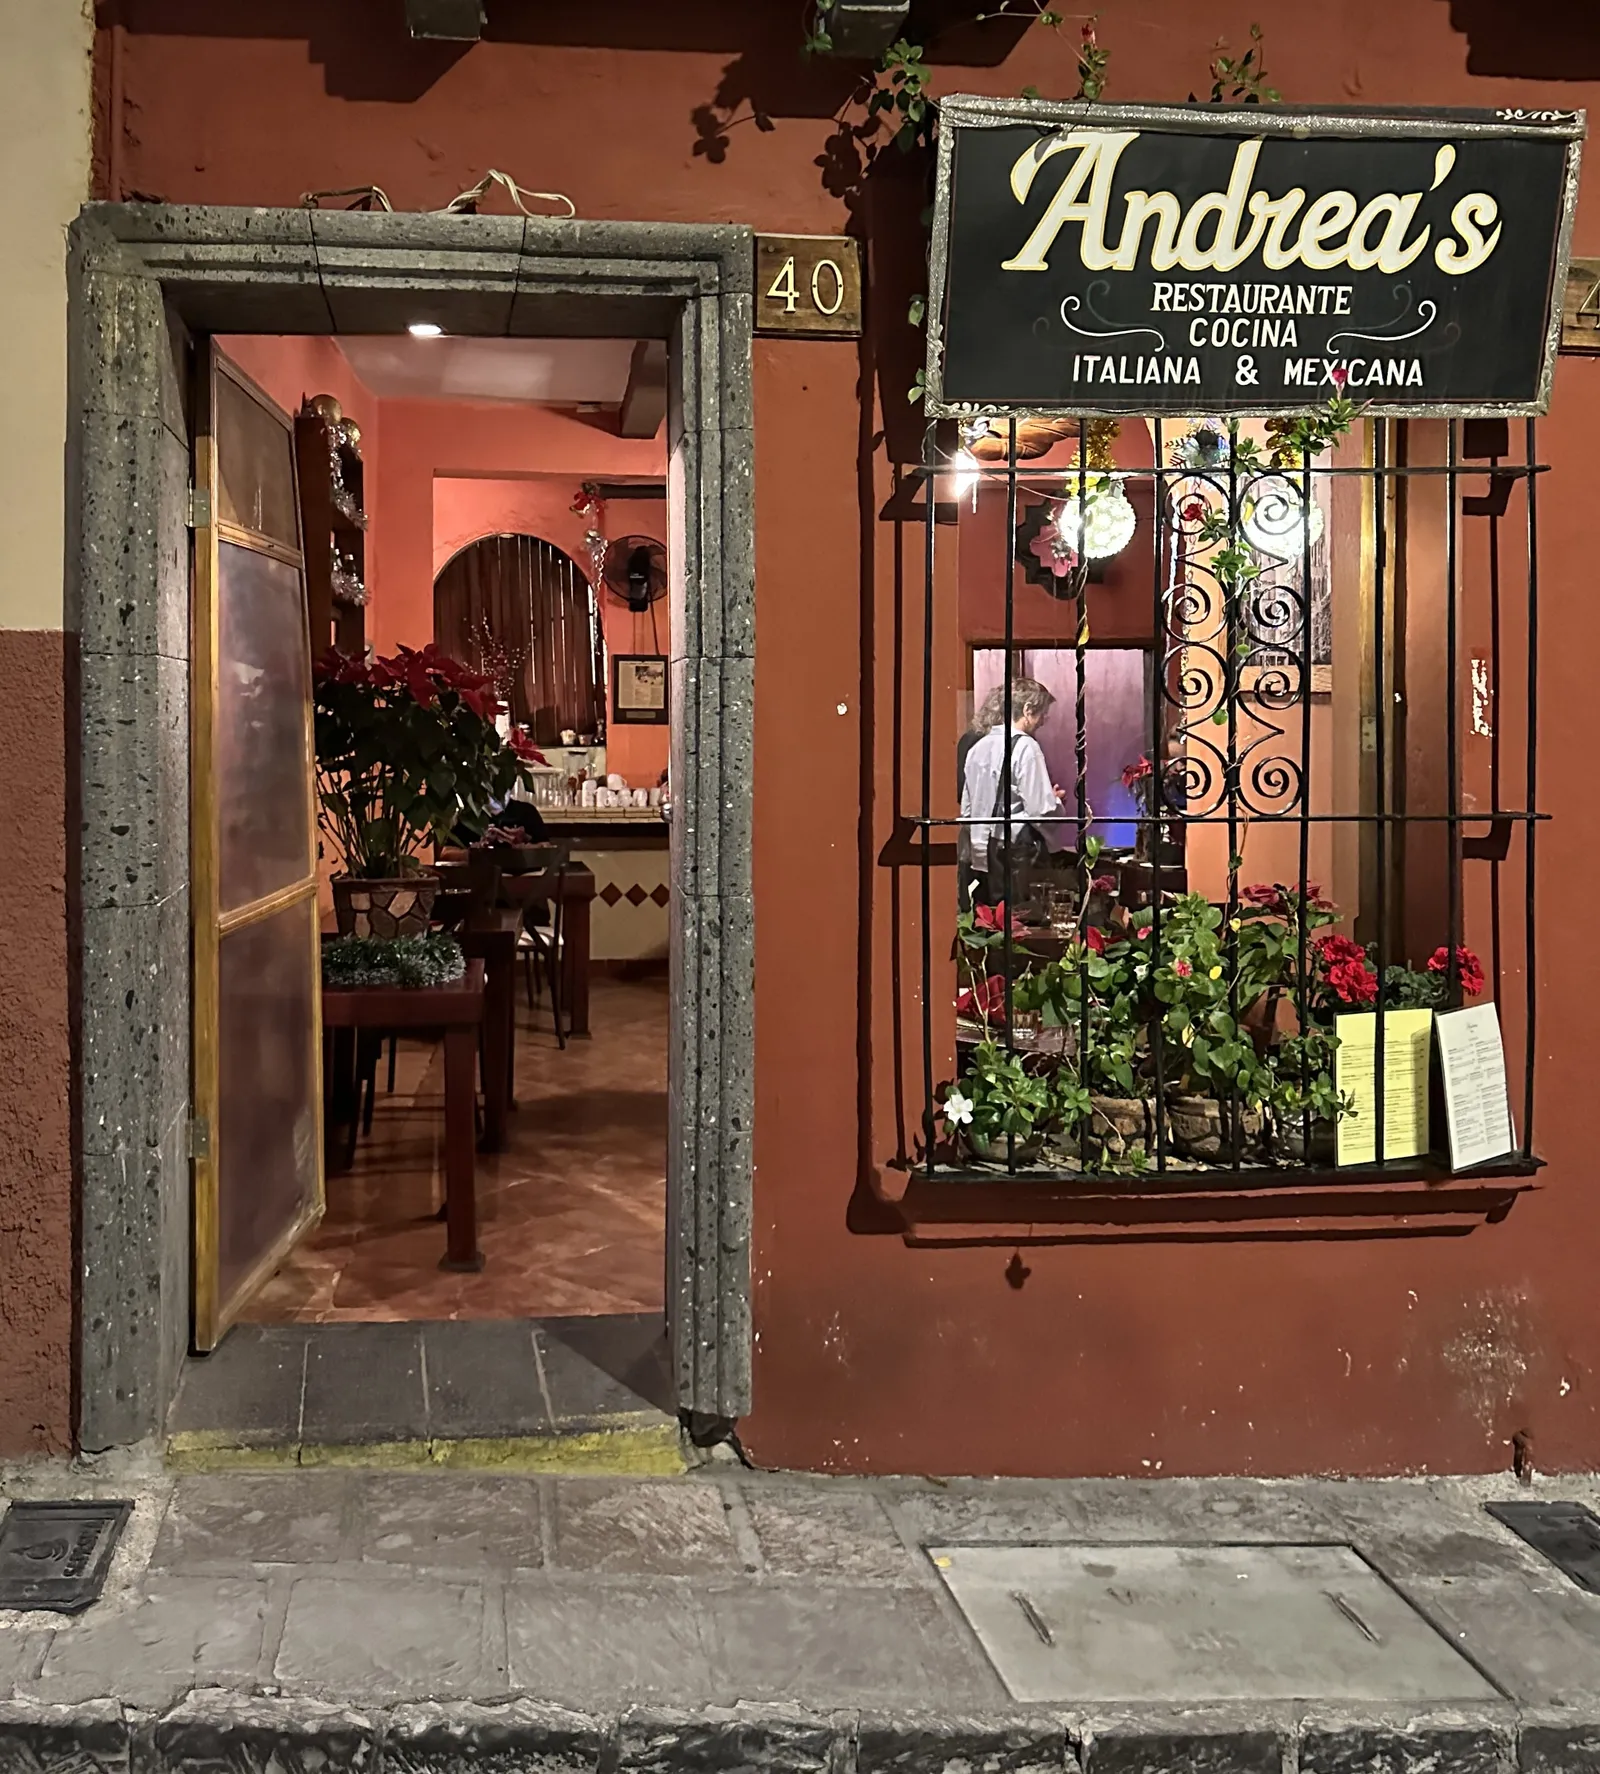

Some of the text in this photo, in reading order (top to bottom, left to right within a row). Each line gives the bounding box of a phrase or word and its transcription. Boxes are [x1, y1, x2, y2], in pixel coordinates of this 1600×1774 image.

[1001, 131, 1502, 274] Andrea's
[766, 256, 844, 315] 40
[1150, 282, 1353, 315] RESTAURANTE
[1189, 317, 1298, 348] COCINA
[1072, 354, 1424, 387] ITALIANA & MEXICANA
